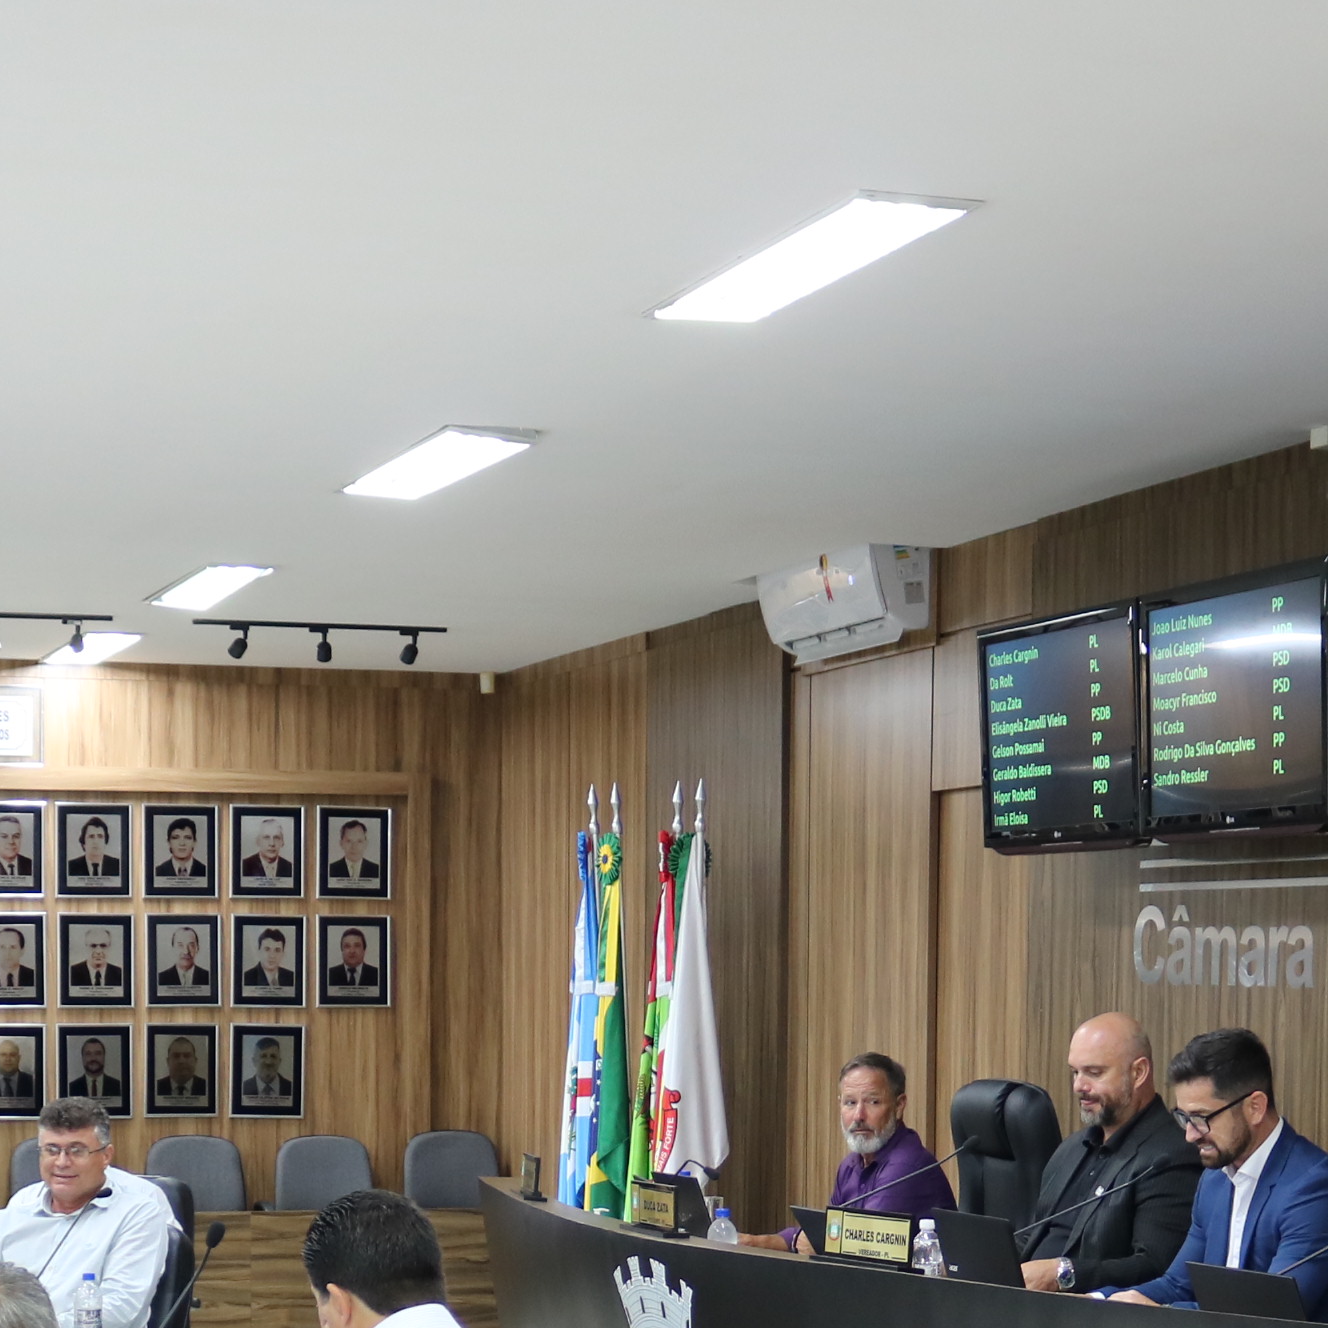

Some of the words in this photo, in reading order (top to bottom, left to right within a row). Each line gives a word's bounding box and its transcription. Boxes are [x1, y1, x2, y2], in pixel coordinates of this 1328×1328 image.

[1172, 617, 1186, 632] Luiz
[1188, 613, 1212, 629] Nunes
[1272, 596, 1283, 612] PP
[989, 651, 1012, 667] Charles
[1014, 646, 1038, 664] Cargnin
[1089, 634, 1098, 648] PL
[1153, 644, 1172, 661] Karol
[1174, 638, 1204, 657] Calegari
[990, 678, 998, 690] Da
[1000, 674, 1013, 687] Rolt
[1090, 659, 1099, 673] PL
[1153, 668, 1182, 686] Marcelo
[1184, 664, 1208, 682] Cunha
[1273, 650, 1289, 666] PSD
[991, 700, 1006, 713] Duca
[1008, 697, 1021, 710] Zata
[1091, 683, 1100, 697] PP
[1153, 695, 1180, 711] Moacyr
[1182, 690, 1216, 707] Francisco
[1273, 677, 1290, 694] PSD
[1024, 715, 1046, 732] Zanolli
[1047, 713, 1067, 728] Vieira
[1092, 706, 1110, 721] PSDB
[1154, 722, 1161, 736] Ni
[1163, 720, 1184, 735] Costa
[1273, 705, 1284, 720] PL
[992, 744, 1014, 758] Gelson
[1015, 739, 1044, 755] Possamai
[1092, 732, 1102, 745] PP
[1154, 746, 1182, 763] Rodrigo
[1185, 744, 1194, 758] Da
[1196, 741, 1213, 756] Silva
[1216, 736, 1255, 756] Gonçalves
[1273, 732, 1285, 748] PP
[993, 766, 1017, 781] Geraldo
[1019, 764, 1051, 779] Baldissera
[1093, 755, 1110, 770] MDB
[1154, 770, 1178, 787] Sandro
[1181, 767, 1209, 784] Ressler
[1273, 759, 1284, 774] PL
[994, 790, 1011, 806] Higor
[1012, 787, 1036, 802] Robetti
[1093, 780, 1108, 794] PSD
[1010, 812, 1028, 825] Eloisa
[1094, 805, 1103, 818] PL
[1134, 905, 1314, 989] Câmara
[663, 1117, 674, 1150] FORTE
[845, 1228, 874, 1243] CHARLES
[876, 1232, 906, 1246] CARGNIN
[858, 1249, 881, 1257] VEREADOR
